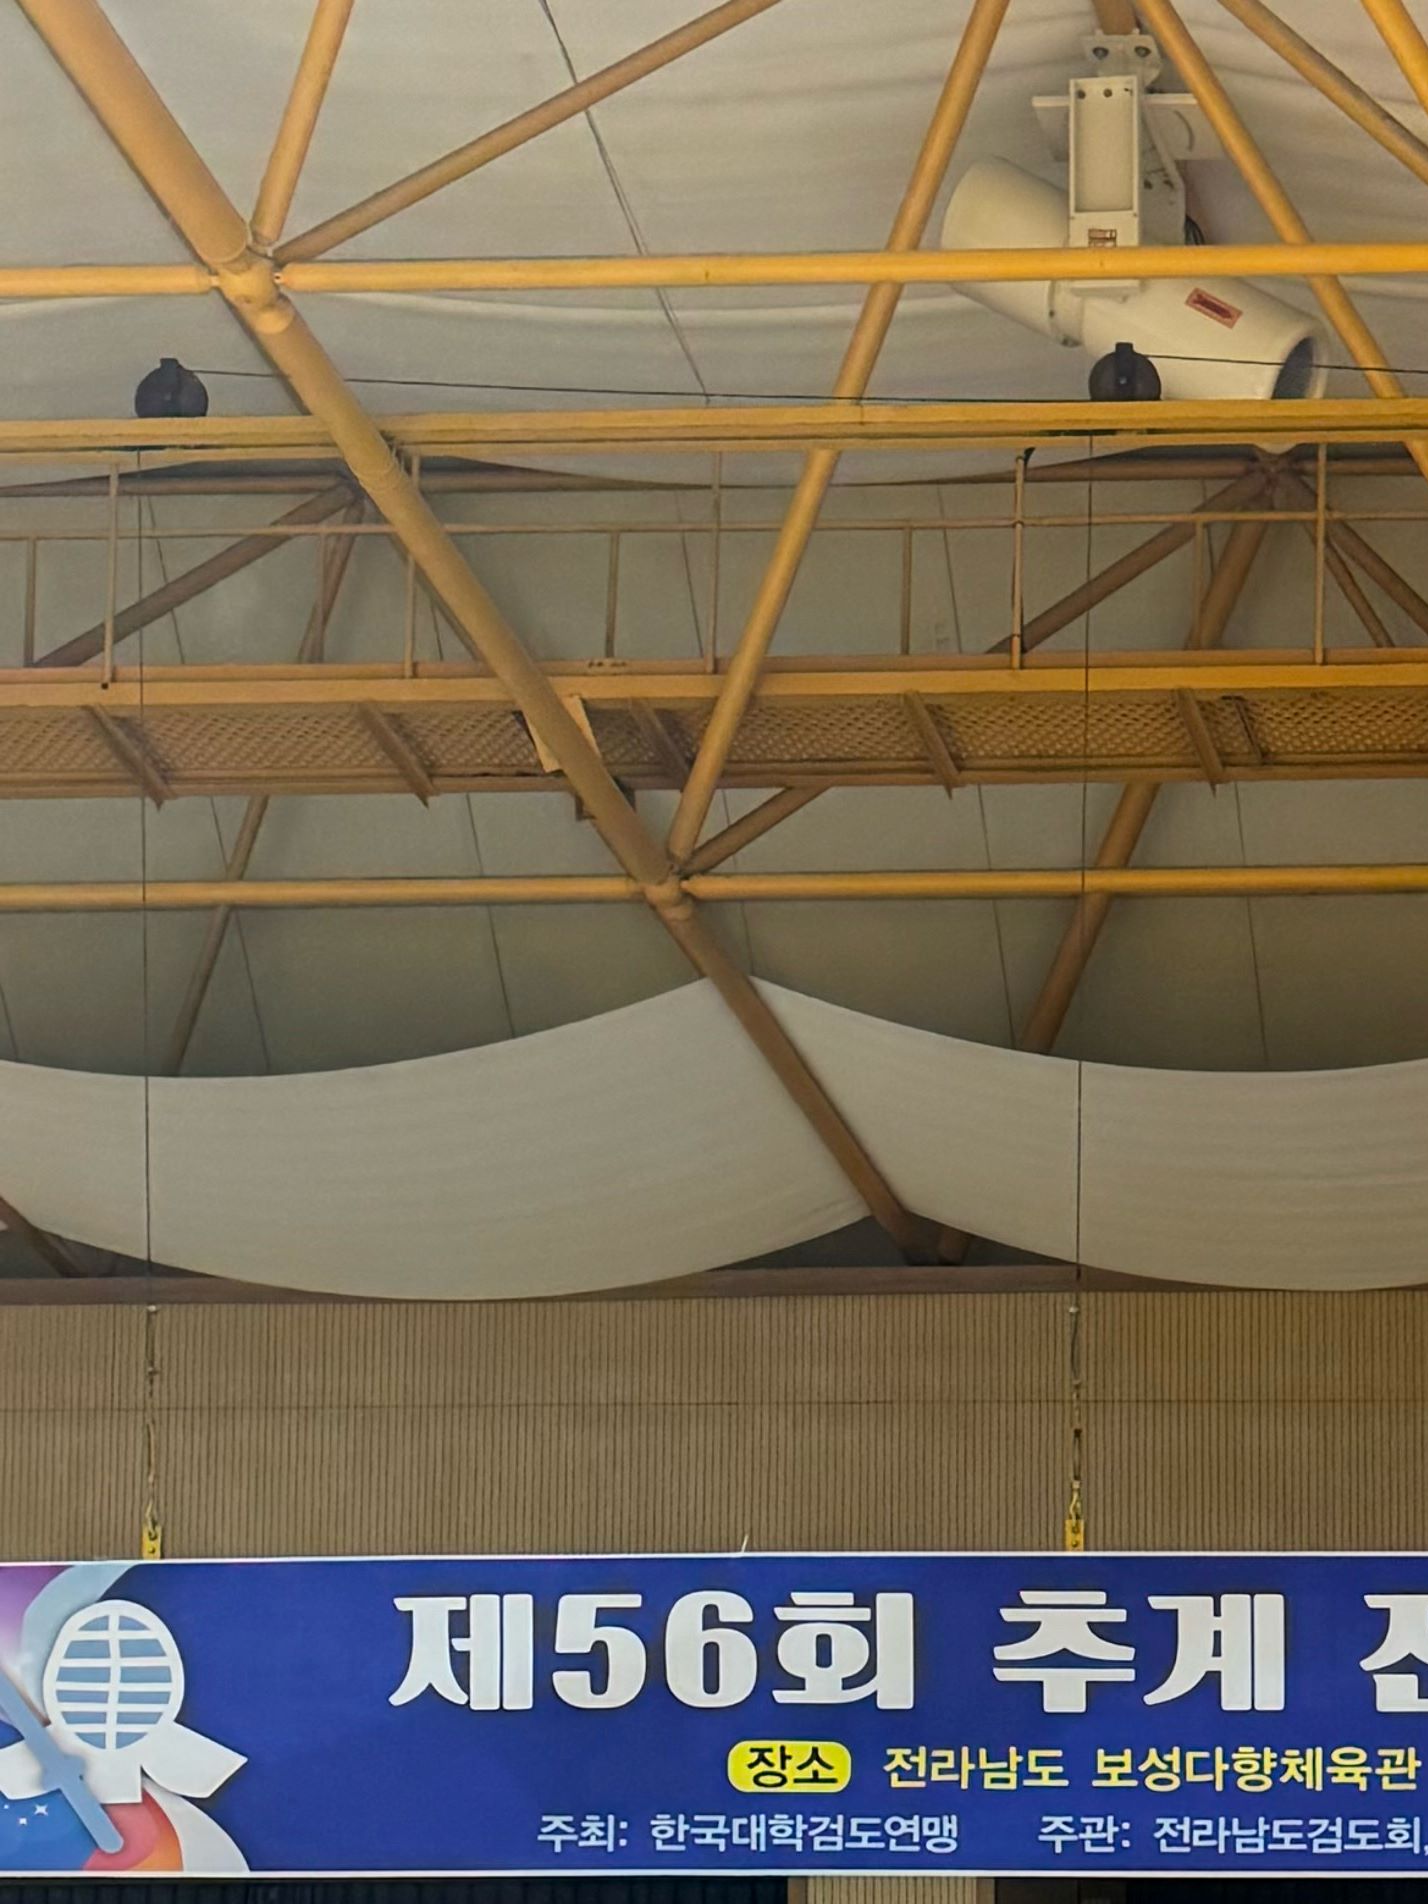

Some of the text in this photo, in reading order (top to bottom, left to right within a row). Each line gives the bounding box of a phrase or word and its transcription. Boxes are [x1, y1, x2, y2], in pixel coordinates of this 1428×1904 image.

[388, 1590, 914, 1711] 제56회
[992, 1591, 1285, 1712] 추계
[746, 1745, 1422, 1792] 장소 전라남도 보성다향체육관
[537, 1814, 957, 1853] 주최: 한국대학검도연맹
[1038, 1815, 1130, 1853] 주관:
